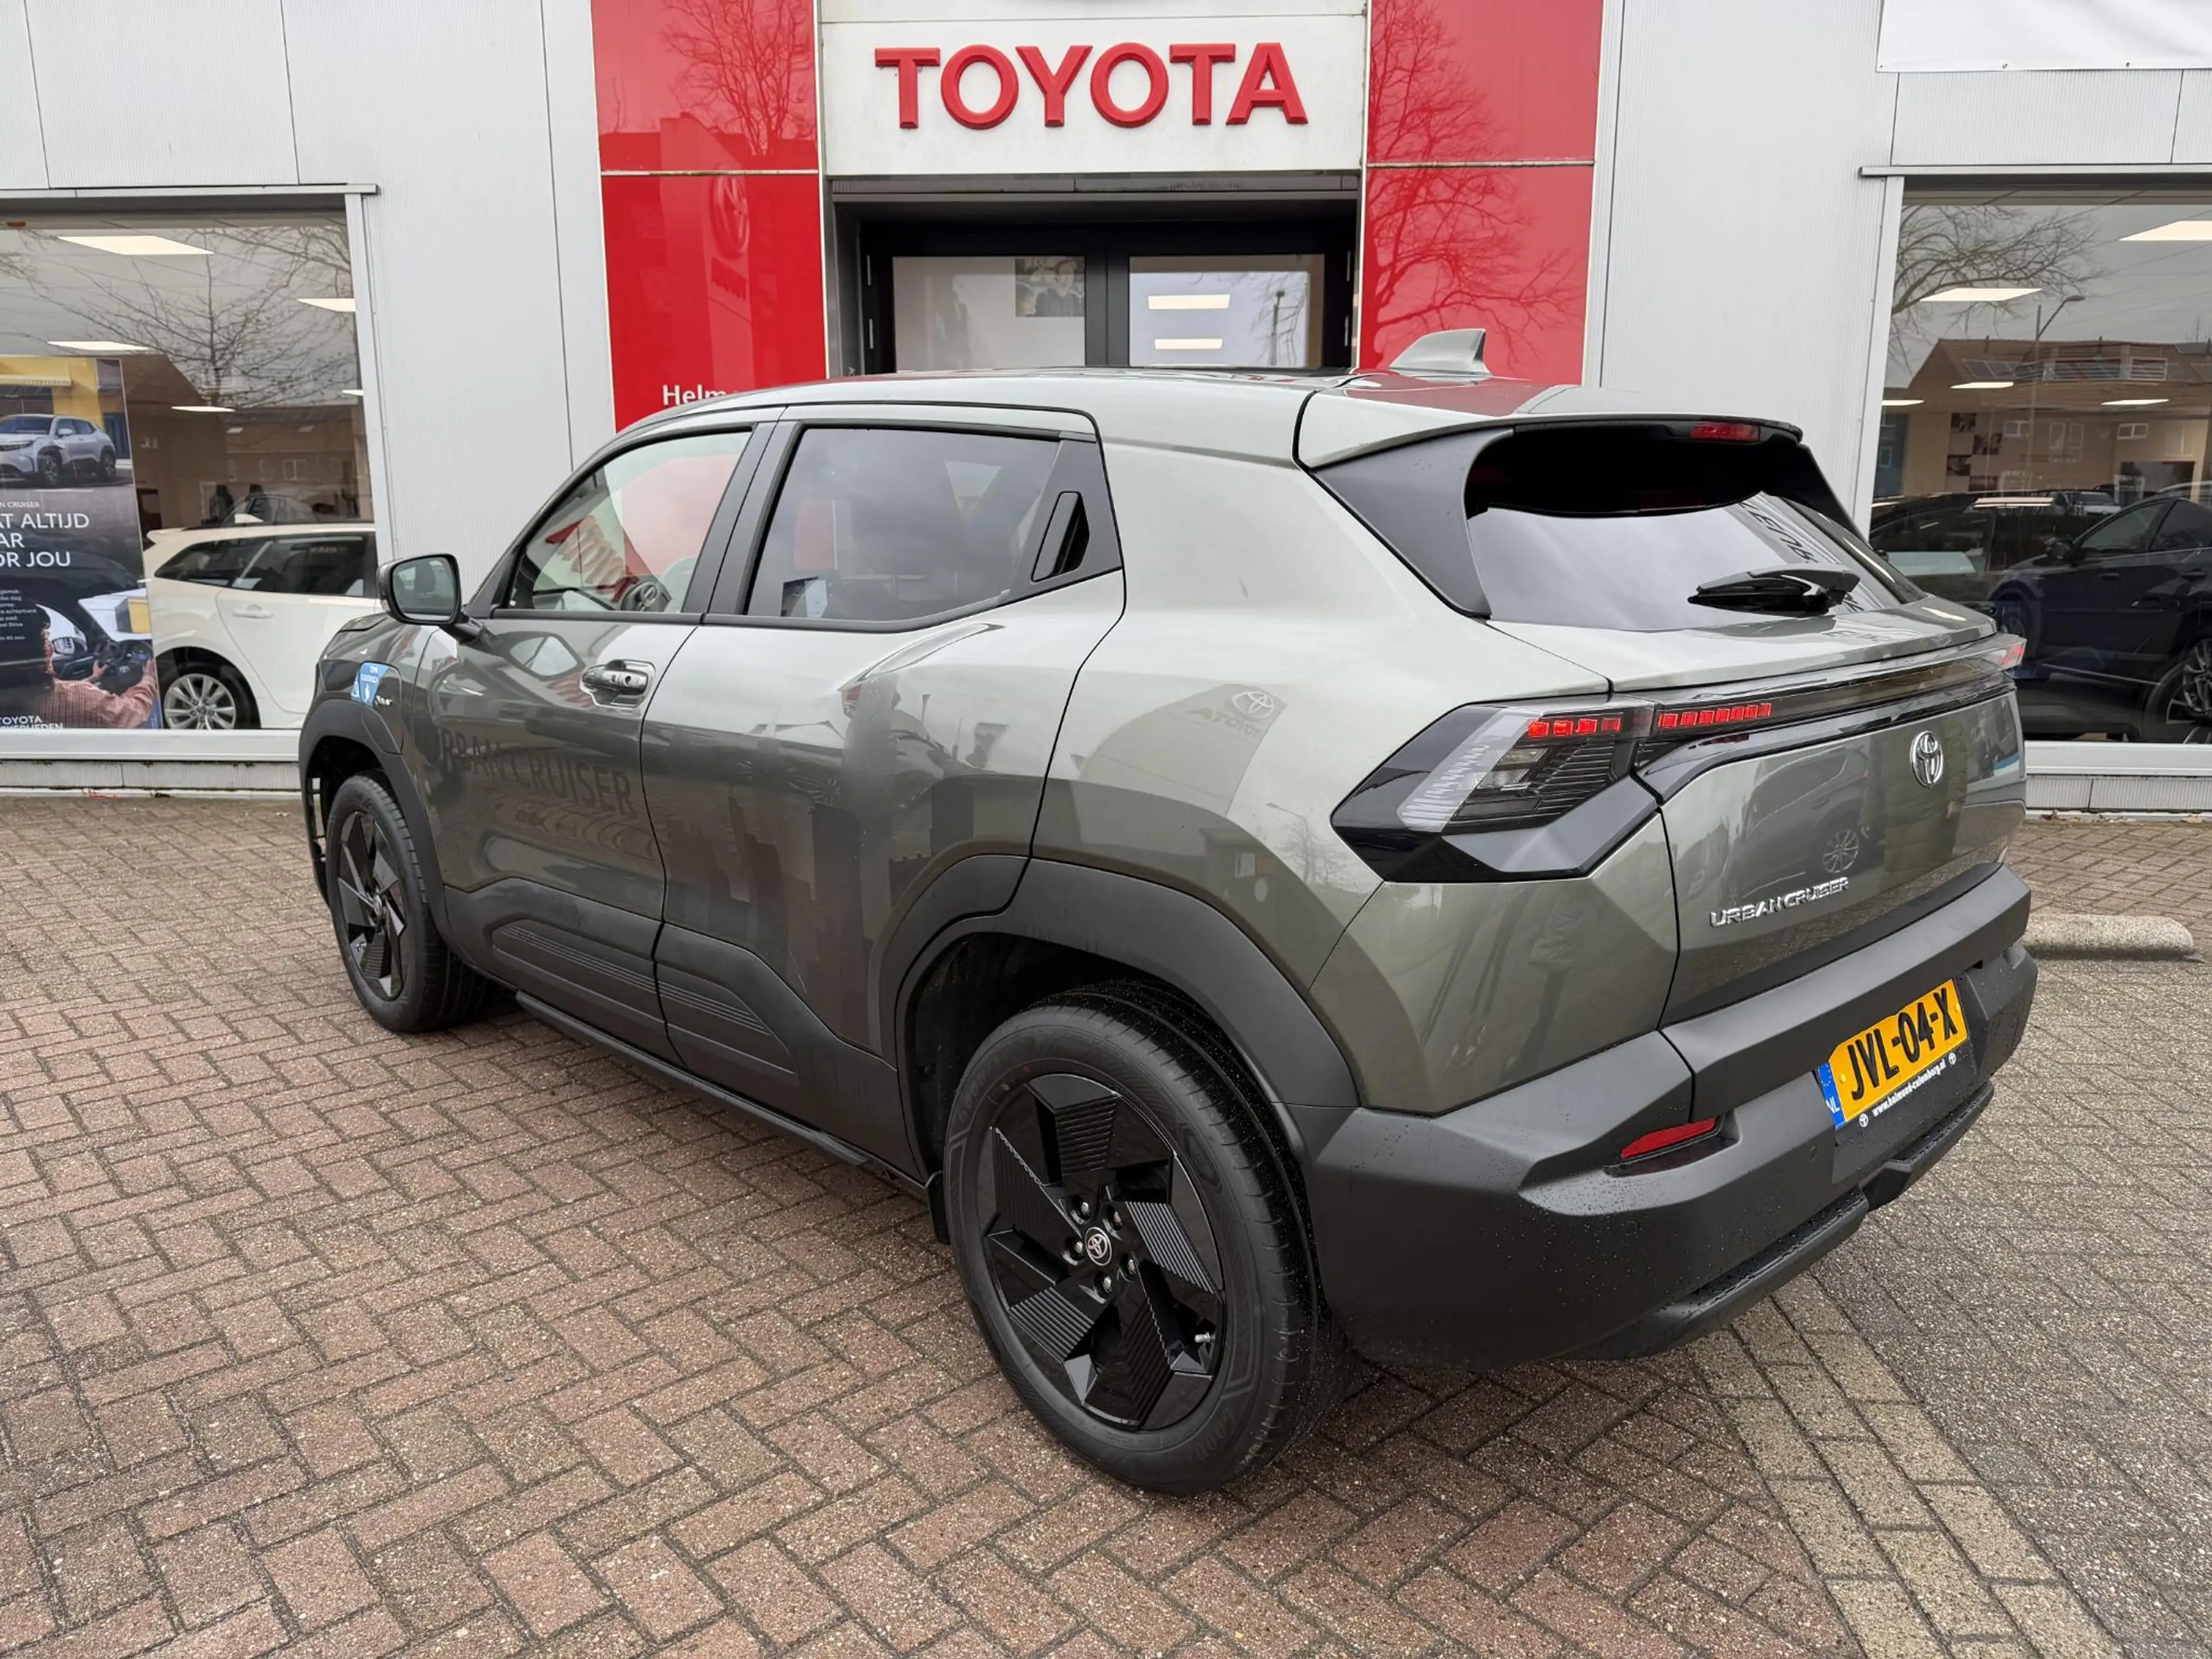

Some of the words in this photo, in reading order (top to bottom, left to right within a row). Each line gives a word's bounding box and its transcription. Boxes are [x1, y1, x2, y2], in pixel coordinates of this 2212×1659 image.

[874, 43, 1308, 130] TOYOTA
[21, 513, 89, 529] ALTIJD
[26, 551, 70, 567] JOU
[1710, 896, 1782, 927] URBAN
[1783, 876, 1849, 908] CRUISER
[1847, 987, 1958, 1101] JVL-04-X
[1825, 1096, 1840, 1113] NL
